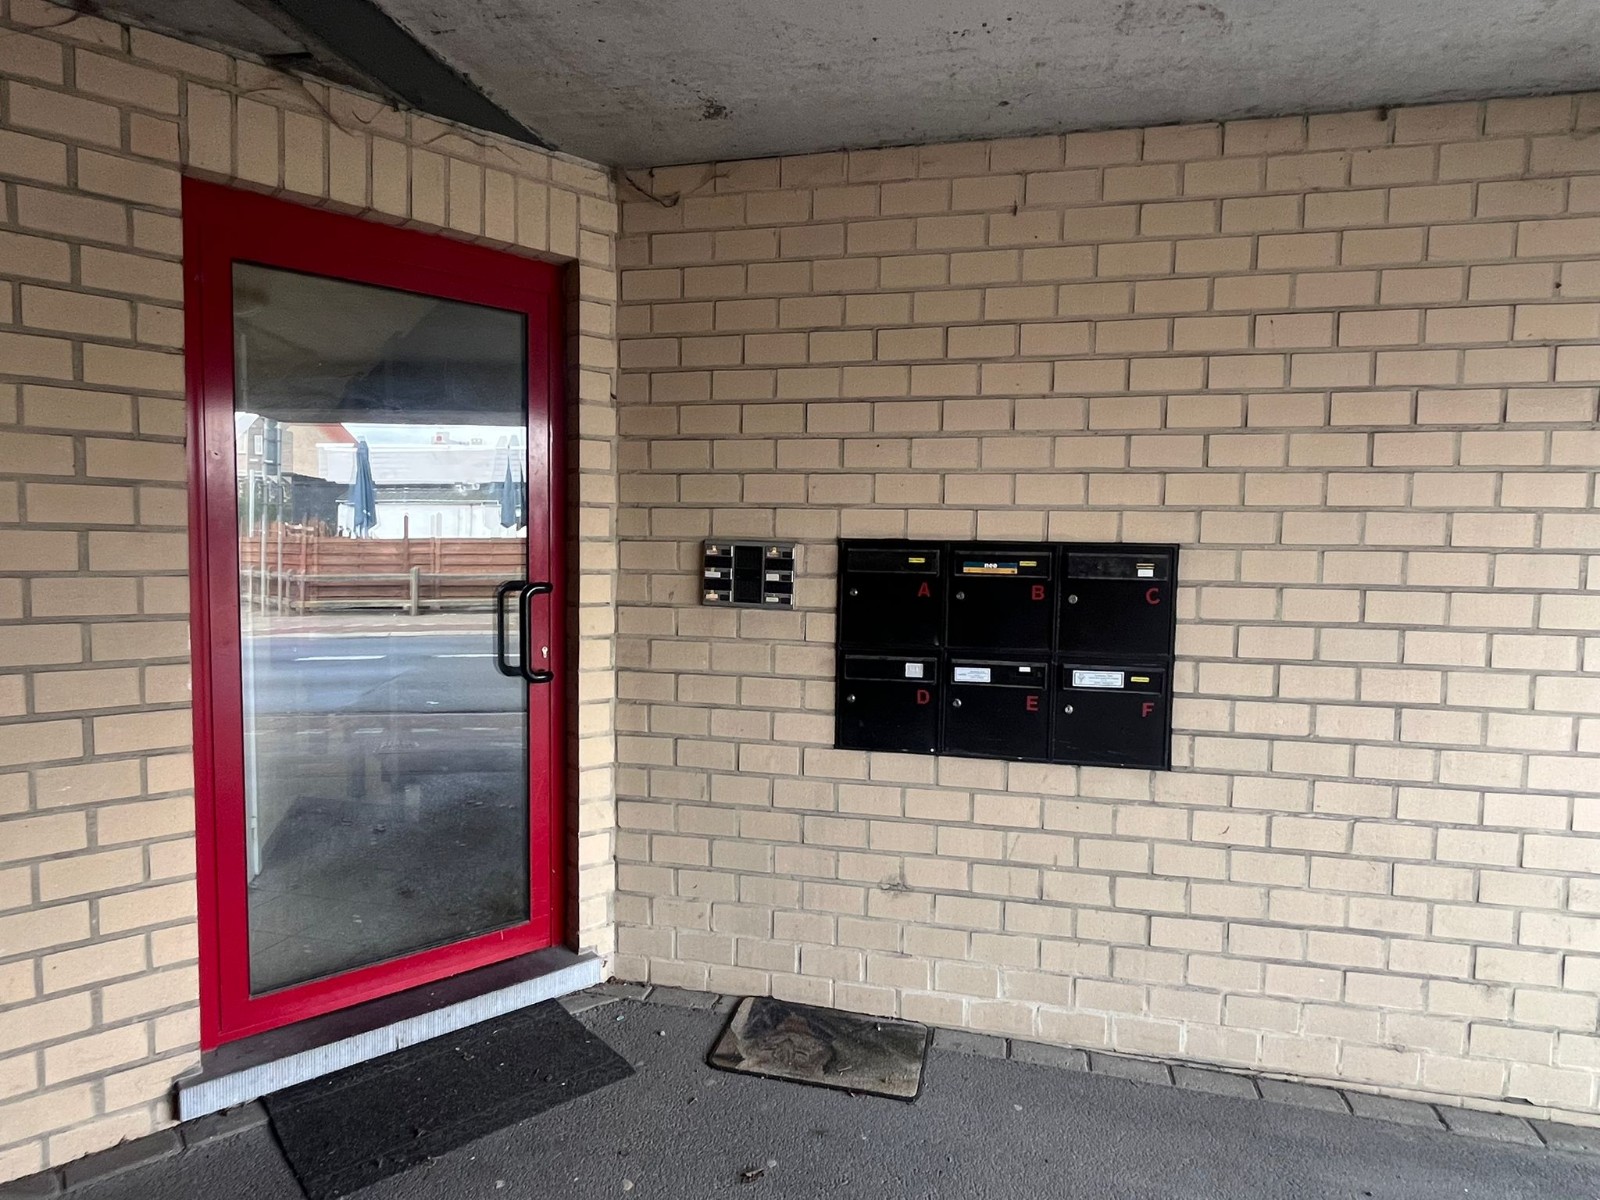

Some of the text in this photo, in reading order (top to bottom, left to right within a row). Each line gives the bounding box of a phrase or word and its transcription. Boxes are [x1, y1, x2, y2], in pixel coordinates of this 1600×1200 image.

[918, 583, 930, 597] A
[1032, 585, 1045, 600] B
[1146, 588, 1160, 604] C
[917, 690, 929, 704] D
[1026, 696, 1038, 711] E
[1142, 703, 1154, 717] F
